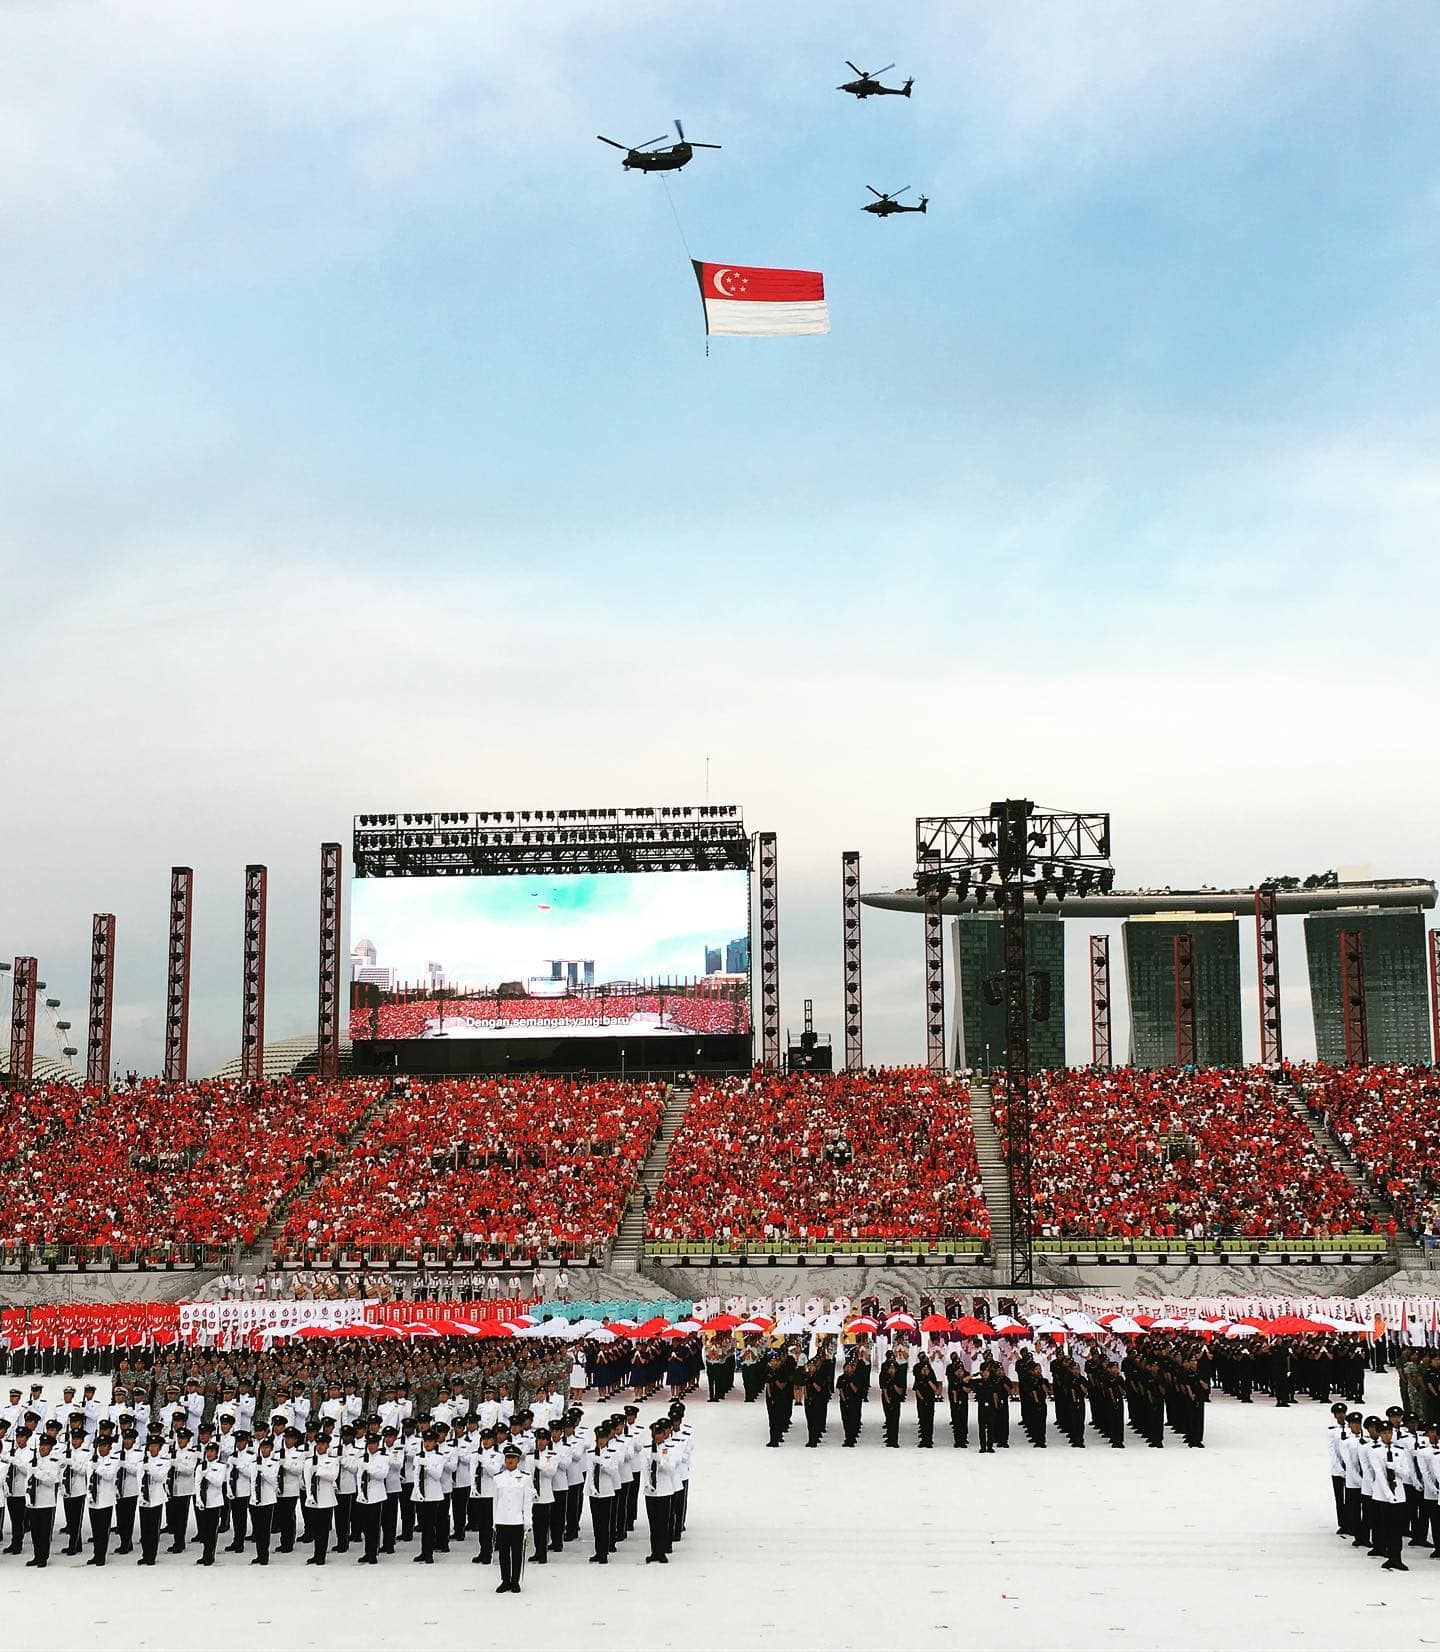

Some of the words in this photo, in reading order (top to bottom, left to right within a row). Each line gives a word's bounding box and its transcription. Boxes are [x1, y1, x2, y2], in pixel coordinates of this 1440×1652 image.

[466, 1017, 510, 1028] Dengan
[513, 1017, 569, 1028] semangat
[571, 1017, 600, 1028] yang
[602, 1015, 630, 1025] baru
